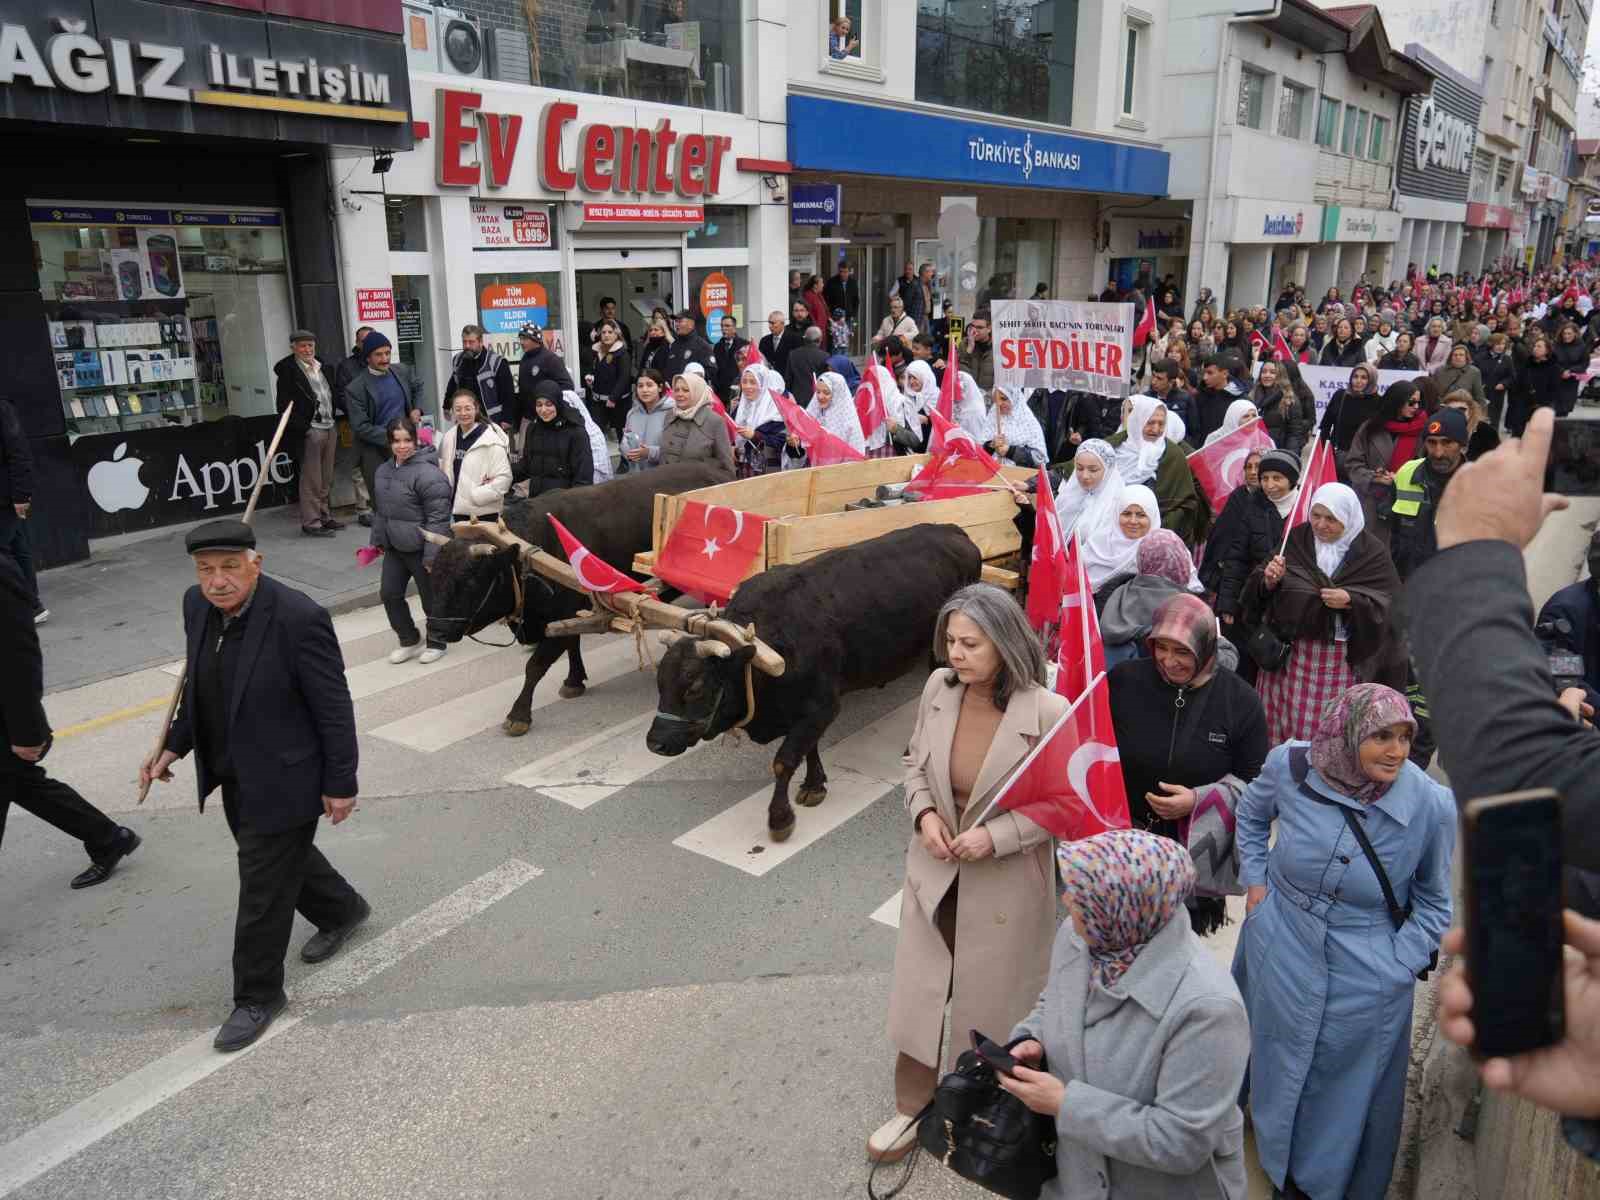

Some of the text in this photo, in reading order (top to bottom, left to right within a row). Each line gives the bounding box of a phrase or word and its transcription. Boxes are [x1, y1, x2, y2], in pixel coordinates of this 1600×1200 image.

[0, 17, 391, 104] AĞIZ İLETİŞİM
[436, 88, 732, 198] Ev Center
[968, 137, 1021, 165] TÜRKİYE
[1034, 150, 1080, 171] BANKASI
[477, 215, 500, 223] YATAK
[481, 226, 501, 234] BAZA
[358, 291, 369, 300] BAY
[374, 291, 391, 300] BAYAN
[505, 286, 522, 296] TÜM
[361, 300, 390, 309] PERSONEL
[492, 297, 537, 307] MOBİLYALAR
[363, 310, 390, 319] ARANIYOR
[504, 310, 527, 320] ELDEN
[1000, 332, 1123, 377] SEYDİLER
[168, 440, 294, 510] Apple
